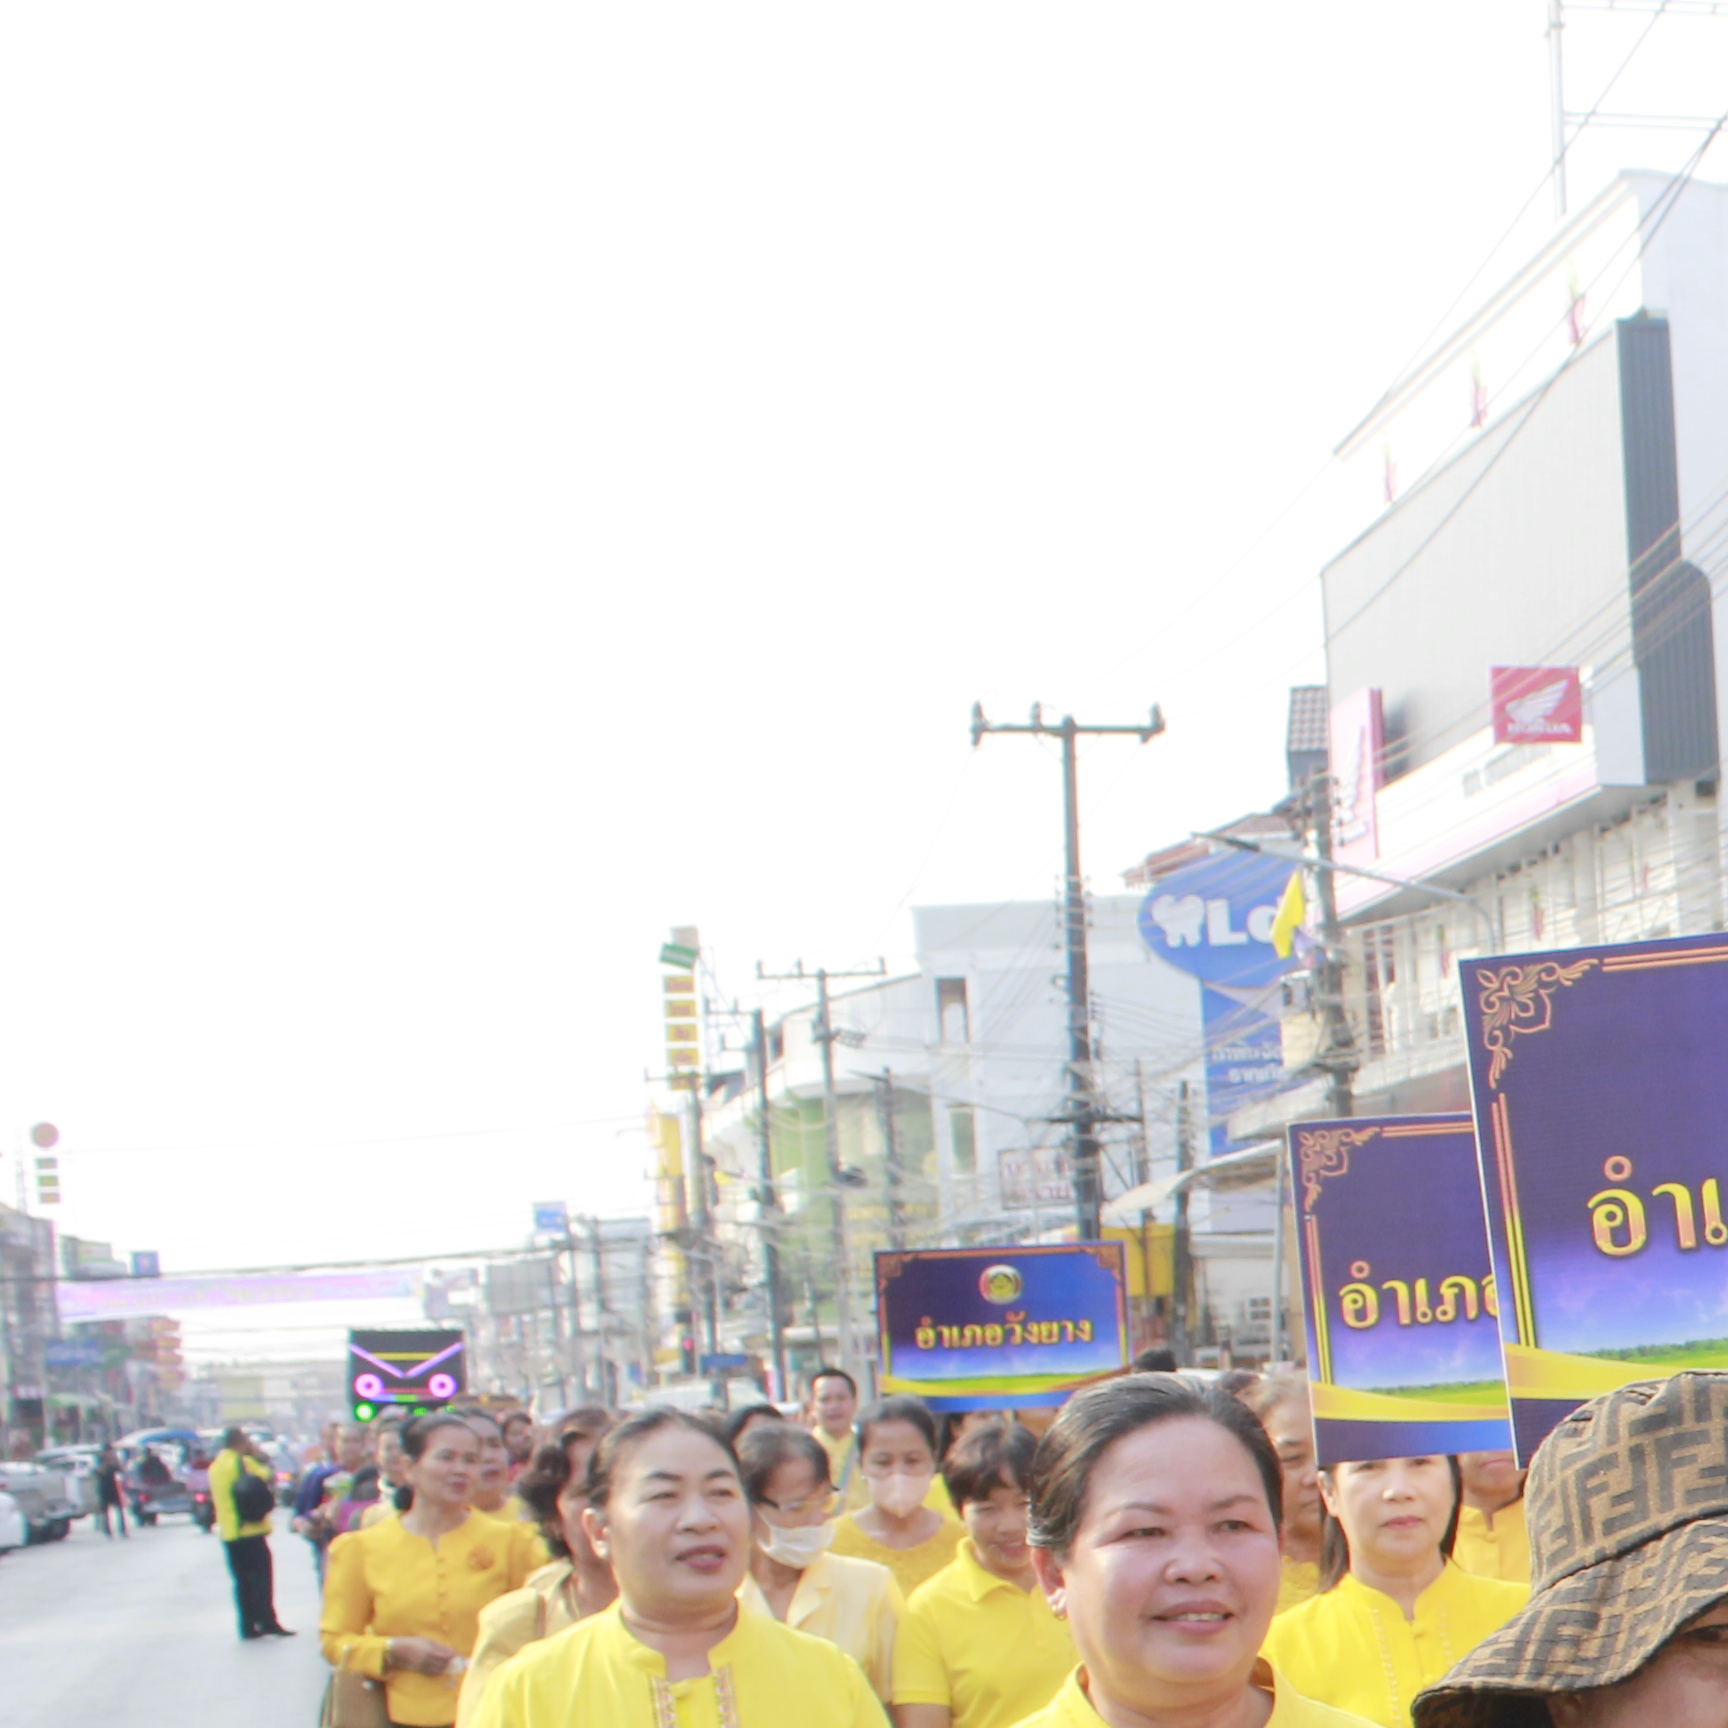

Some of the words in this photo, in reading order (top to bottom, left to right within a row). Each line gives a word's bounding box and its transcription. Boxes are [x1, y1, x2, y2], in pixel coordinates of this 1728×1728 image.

[915, 1309, 1095, 1350] อำเภอวังยาง
